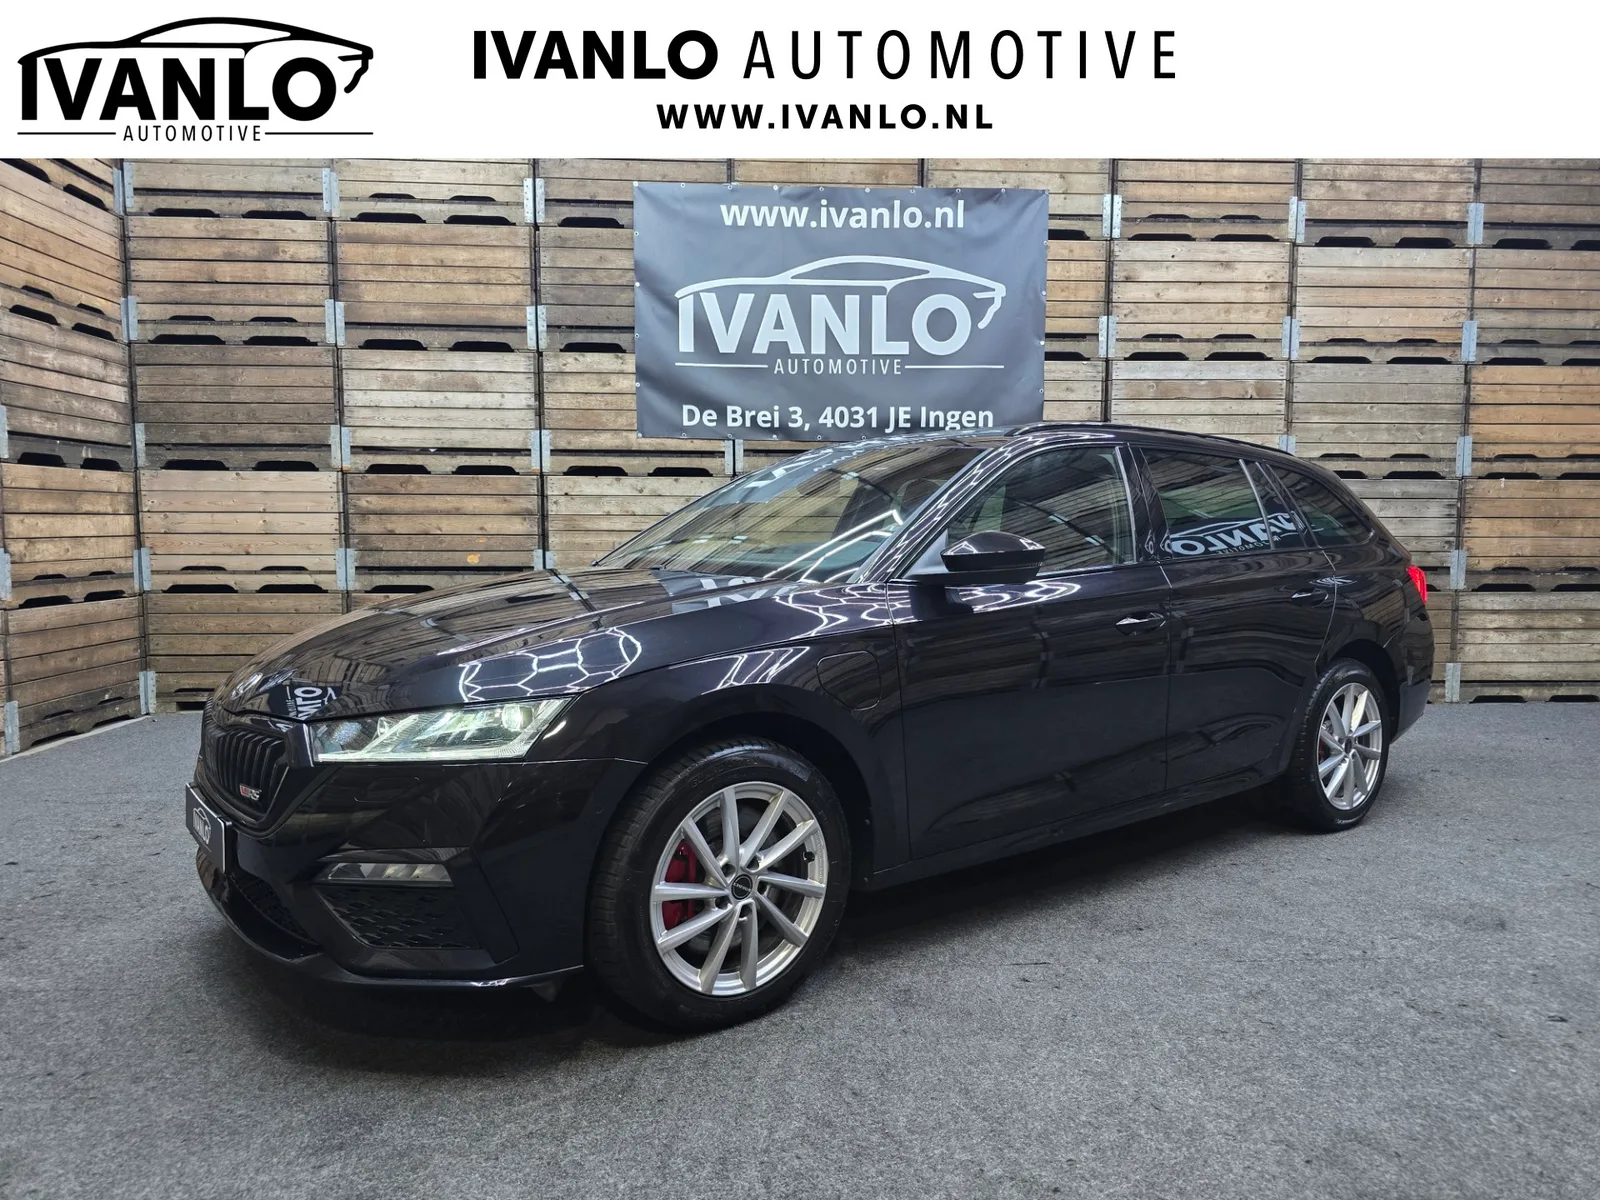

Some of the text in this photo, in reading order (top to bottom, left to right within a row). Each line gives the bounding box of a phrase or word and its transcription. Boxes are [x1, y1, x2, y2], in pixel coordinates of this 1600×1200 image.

[720, 200, 965, 229] www.ivanlo.nl
[678, 293, 972, 356] IVANLO
[773, 358, 902, 375] AUTOMOTIVE
[682, 405, 994, 434] De Brei 3, 4031 JE Ingen
